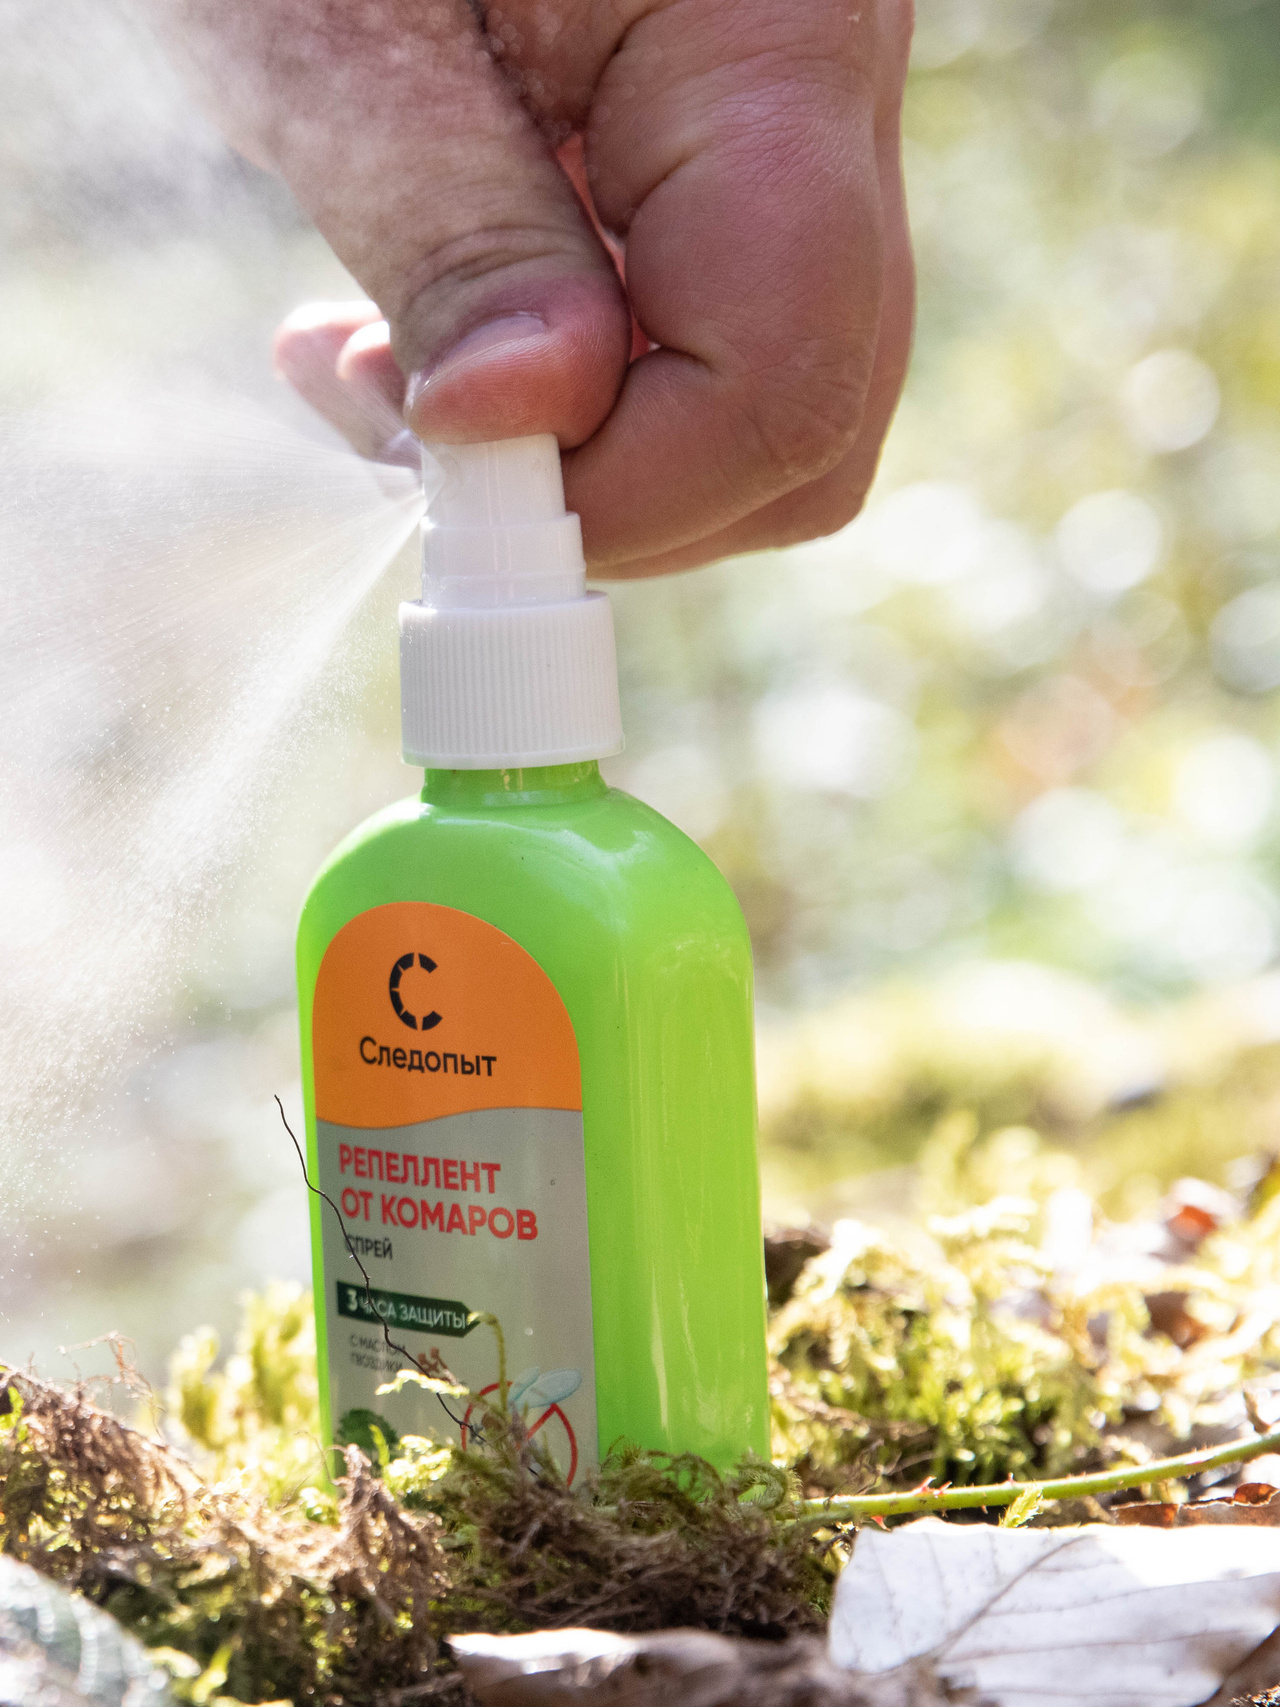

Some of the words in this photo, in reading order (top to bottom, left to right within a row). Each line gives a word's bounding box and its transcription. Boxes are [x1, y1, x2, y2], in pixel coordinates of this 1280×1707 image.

[359, 1036, 497, 1077] Следопыт
[339, 1143, 501, 1194] РЕПЕЛЛЕНТ
[341, 1187, 373, 1221] ОТ
[381, 1193, 538, 1240] КОМАРОВ
[345, 1234, 393, 1260] СПРЕЙ
[347, 1288, 358, 1311] 3
[400, 1304, 466, 1329] ЗАЩИТЫ
[349, 1333, 359, 1348] С
